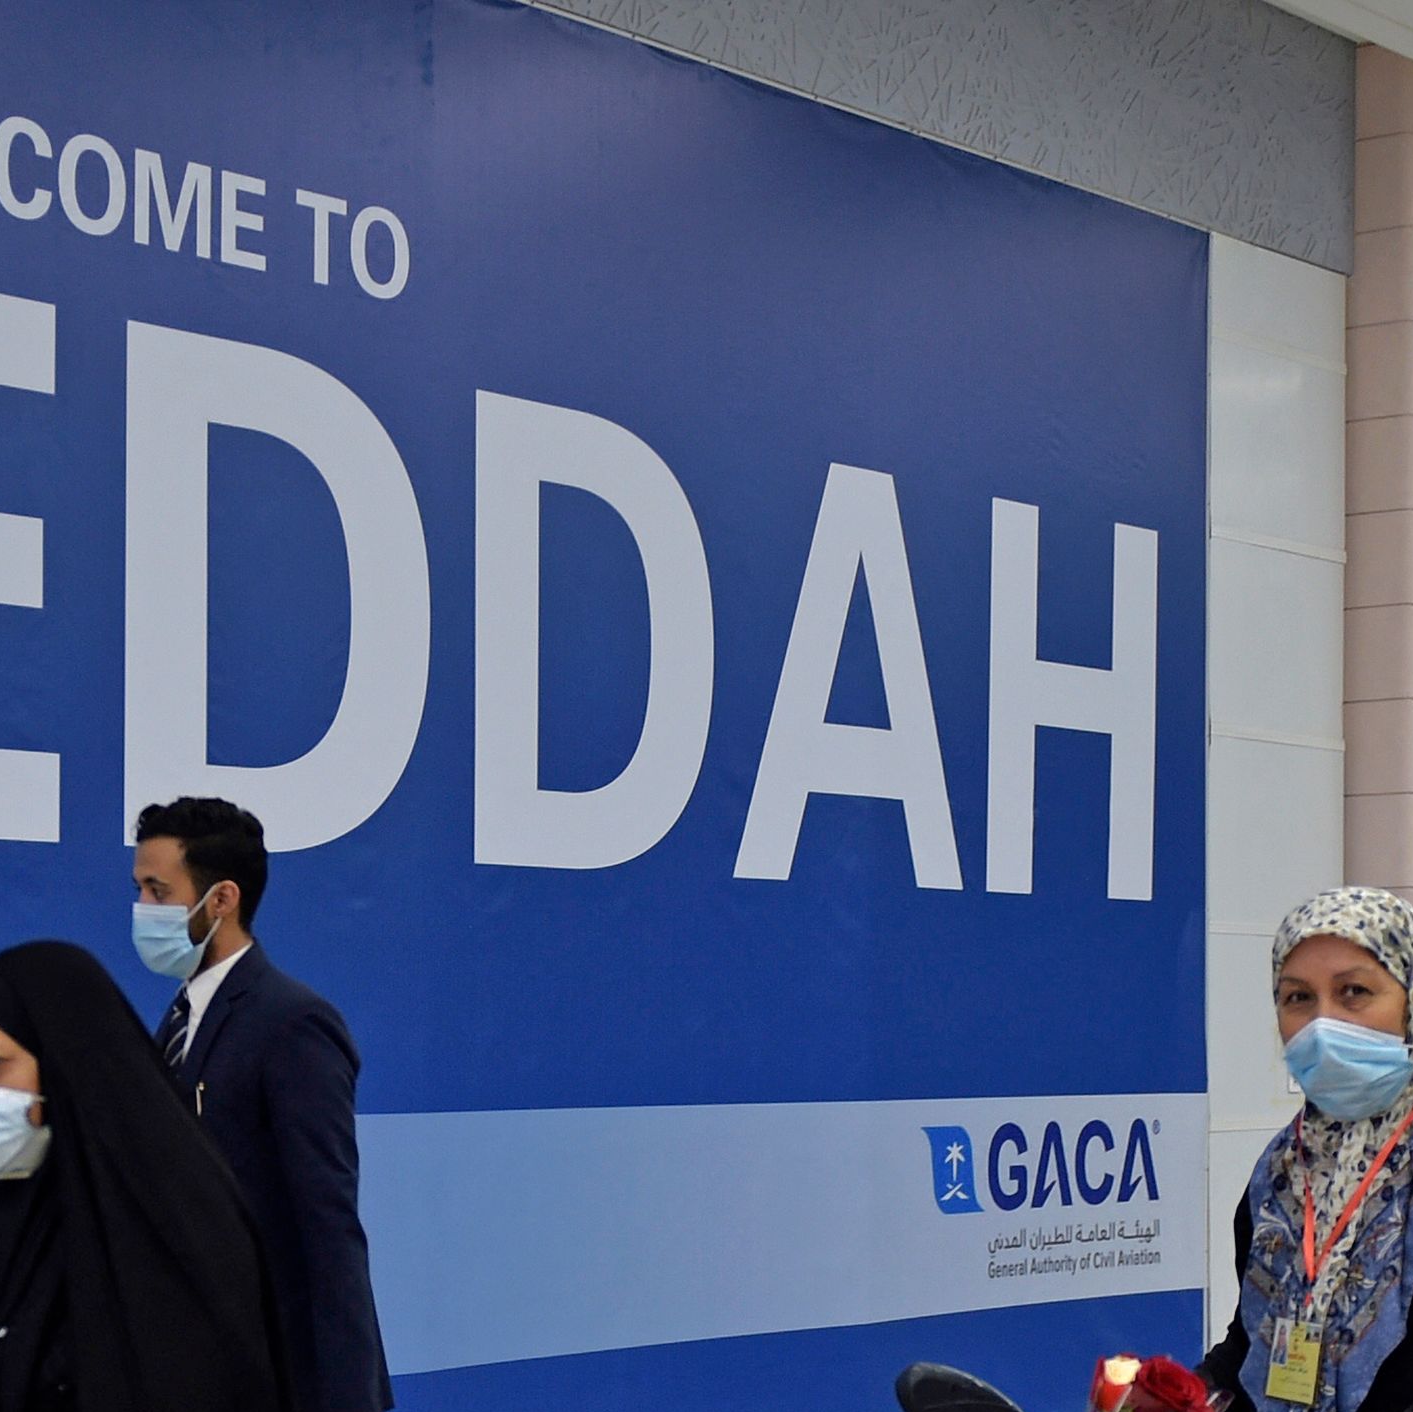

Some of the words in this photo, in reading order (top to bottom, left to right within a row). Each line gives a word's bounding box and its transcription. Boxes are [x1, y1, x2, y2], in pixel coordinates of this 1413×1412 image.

[295, 188, 410, 300] TO
[988, 1118, 1159, 1212] GACA
[988, 1228, 1027, 1258] المدني
[1029, 1225, 1074, 1251] للطيران
[1075, 1222, 1116, 1243] العامة
[988, 1258, 1028, 1279] General
[1030, 1254, 1077, 1276] Authority
[1079, 1252, 1092, 1270] of
[1093, 1249, 1115, 1269] Civil
[1117, 1248, 1161, 1267] Aviation
